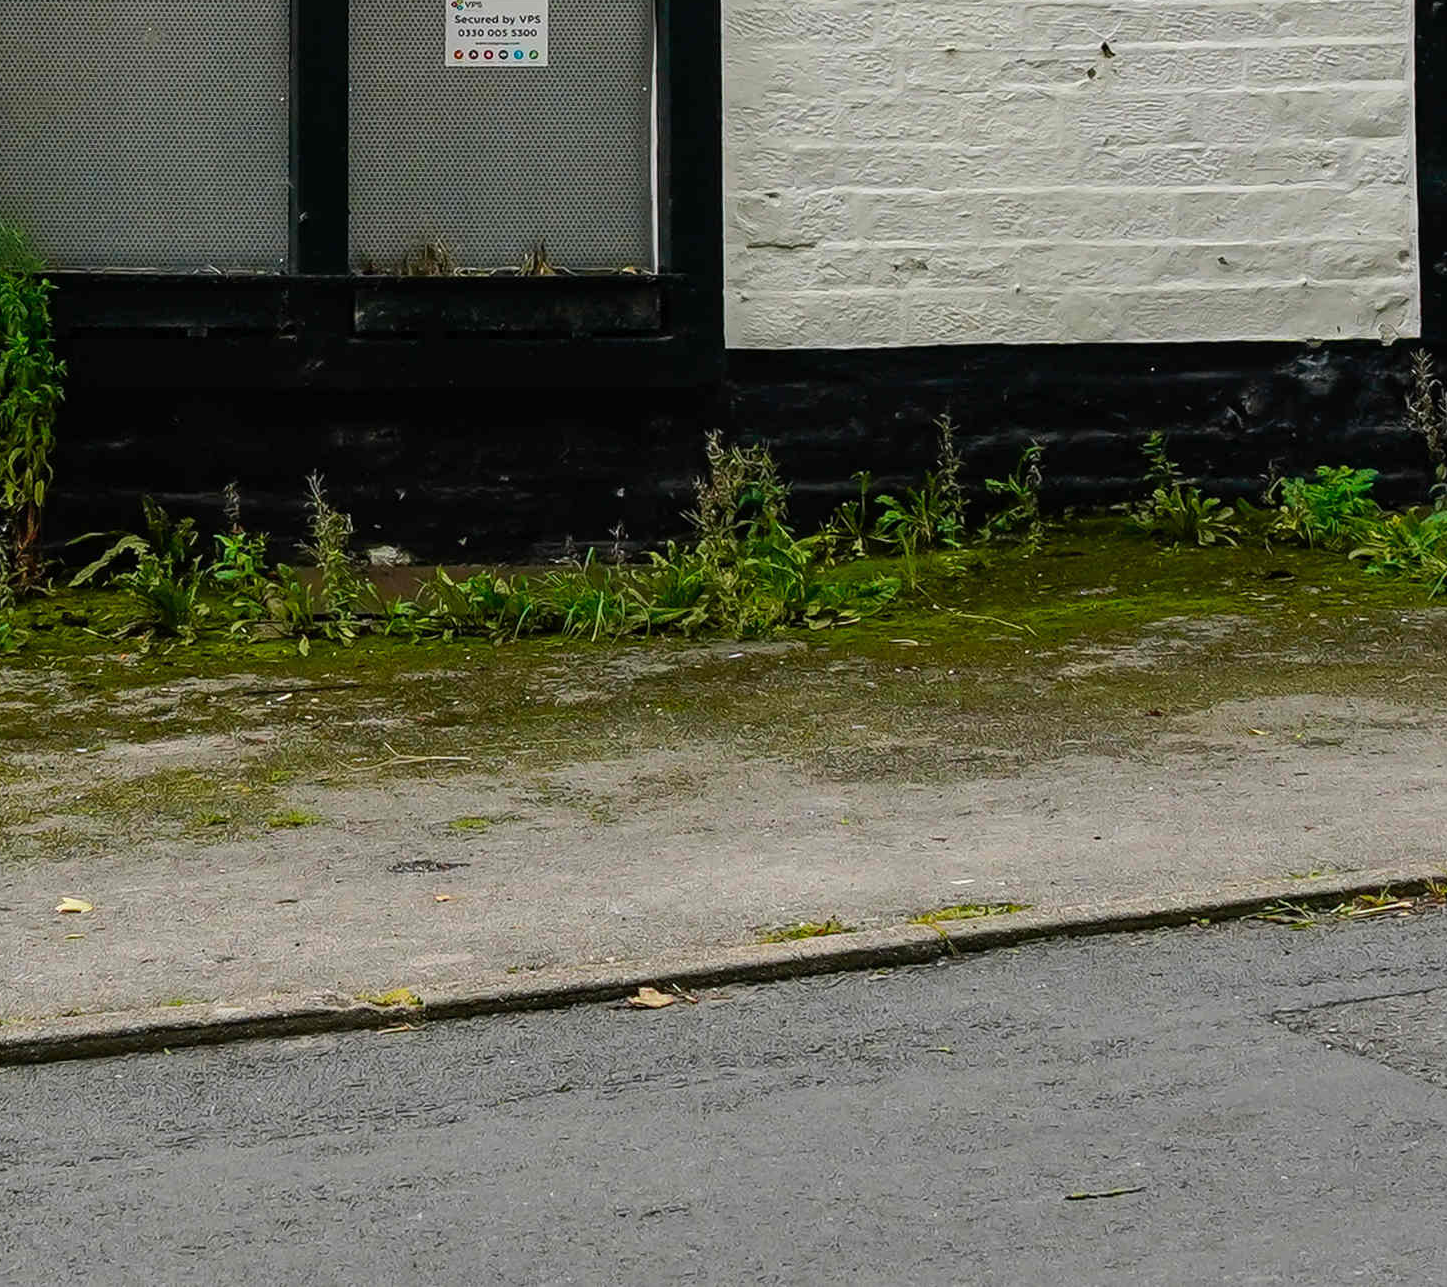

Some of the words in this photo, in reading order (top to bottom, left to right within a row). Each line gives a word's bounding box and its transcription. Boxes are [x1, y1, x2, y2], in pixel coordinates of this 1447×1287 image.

[454, 14, 499, 24] Secured
[502, 15, 515, 25] by
[519, 14, 541, 24] VPS
[458, 29, 484, 37] 0330
[487, 29, 507, 37] 005
[511, 29, 538, 37] 5300
